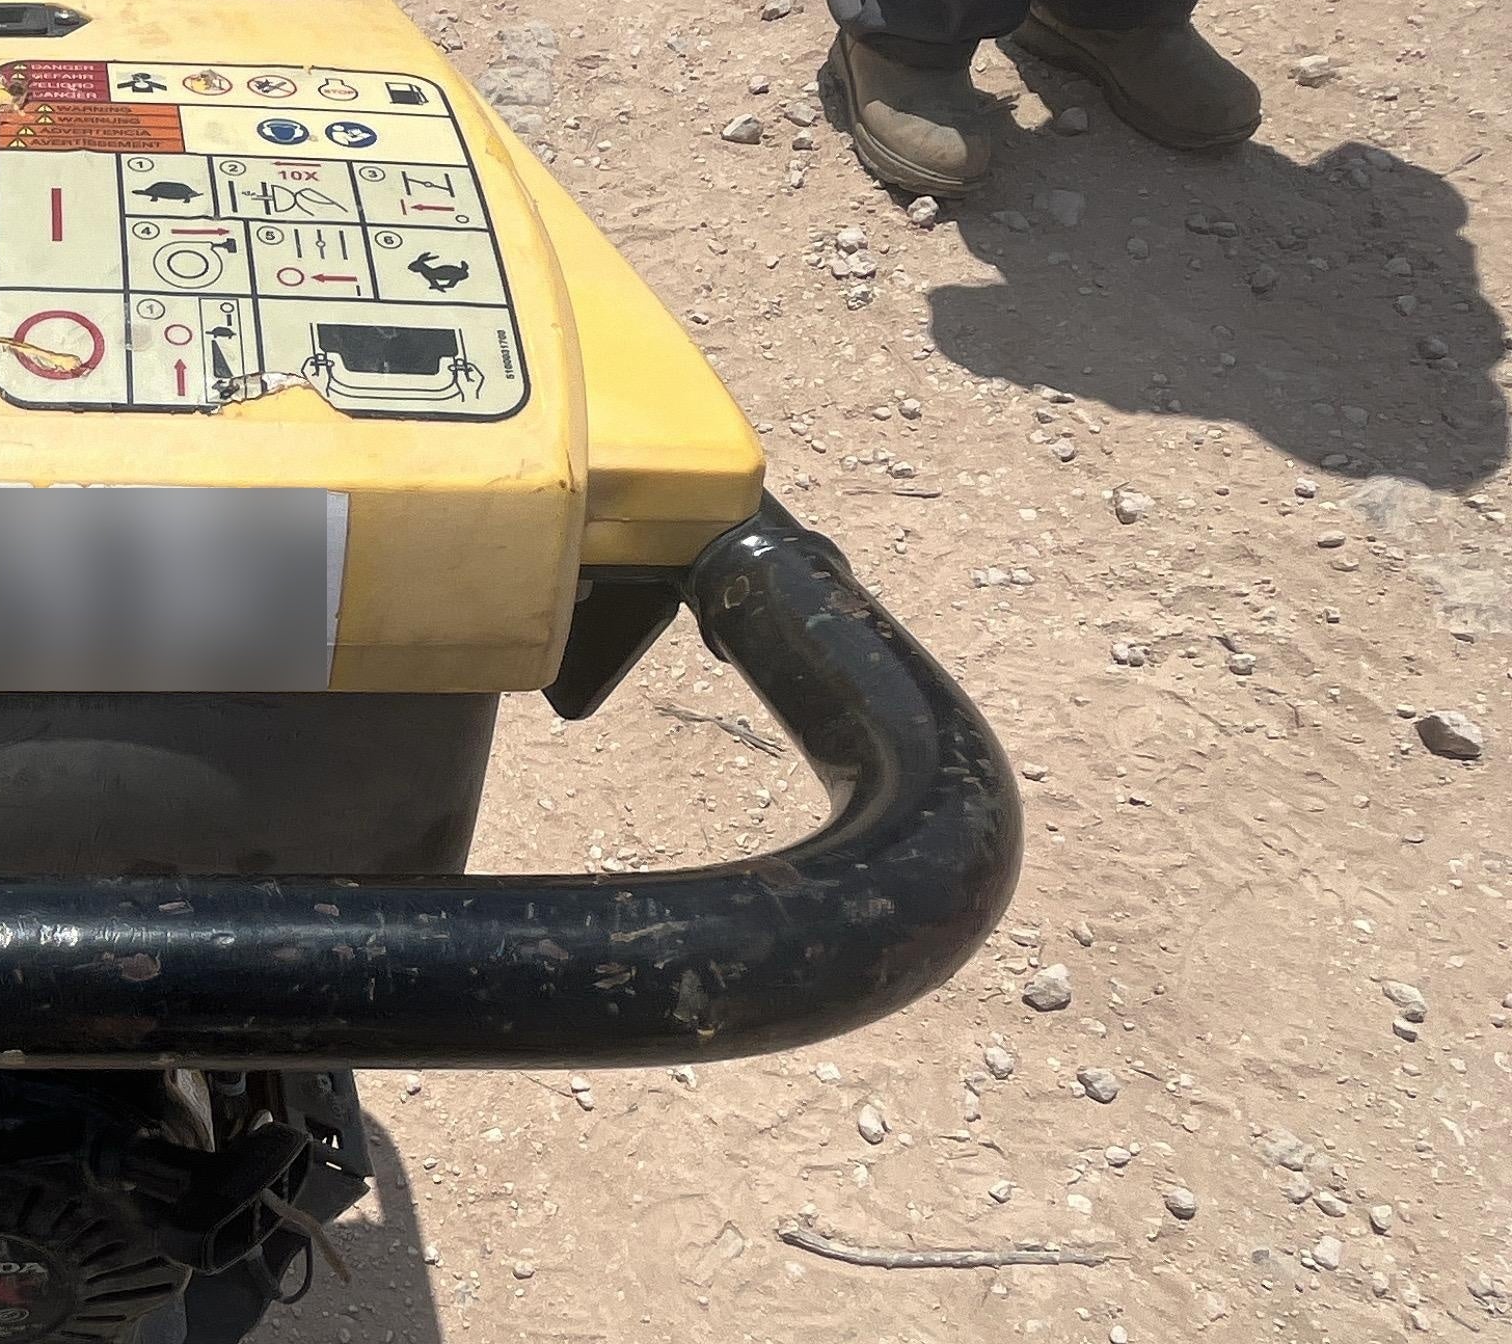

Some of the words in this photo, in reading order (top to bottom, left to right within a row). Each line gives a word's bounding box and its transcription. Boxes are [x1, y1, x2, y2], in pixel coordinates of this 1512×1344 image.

[30, 63, 95, 71] DANGER
[56, 105, 133, 114] WARNING
[39, 127, 152, 137] ADVERTENCIA
[277, 170, 320, 182] 10X
